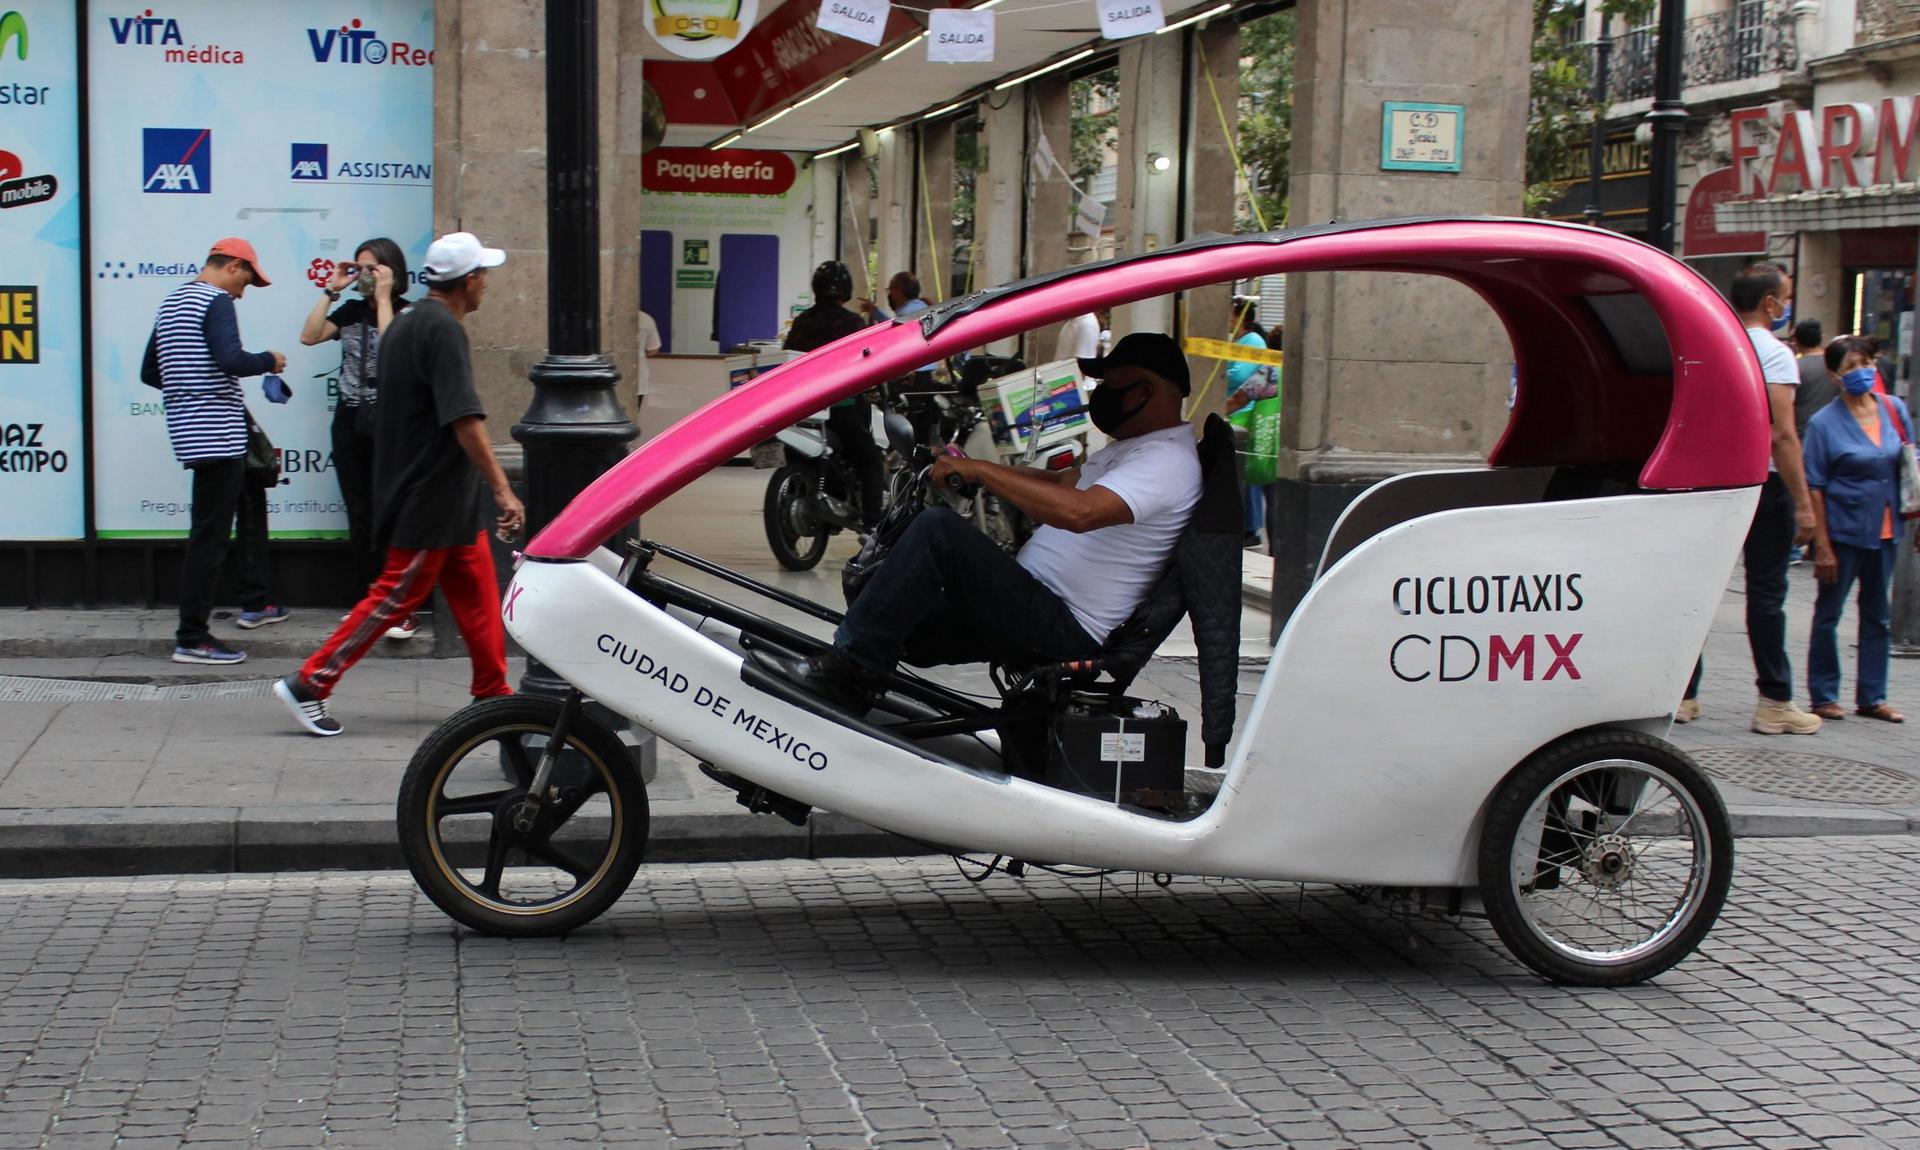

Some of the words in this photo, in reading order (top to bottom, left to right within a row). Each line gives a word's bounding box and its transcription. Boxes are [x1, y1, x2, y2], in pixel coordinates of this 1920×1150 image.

[675, 17, 719, 31] ORO
[831, 3, 876, 25] SALIDA
[1107, 5, 1152, 22] SALIDA
[938, 33, 984, 44] SALIDA
[165, 45, 244, 64] médica
[144, 164, 200, 190] AXA
[291, 161, 323, 177] AXA
[338, 162, 431, 179] ASSISTAN
[657, 159, 774, 182] Paquetería
[2, 180, 51, 202] mobile
[0, 423, 44, 447] AZ
[1393, 573, 1584, 615] CICLOTAXIS
[1389, 633, 1584, 683] CDMX
[596, 633, 689, 694] CIUDAD
[693, 686, 731, 718] DE
[733, 708, 828, 772] MEXICO
